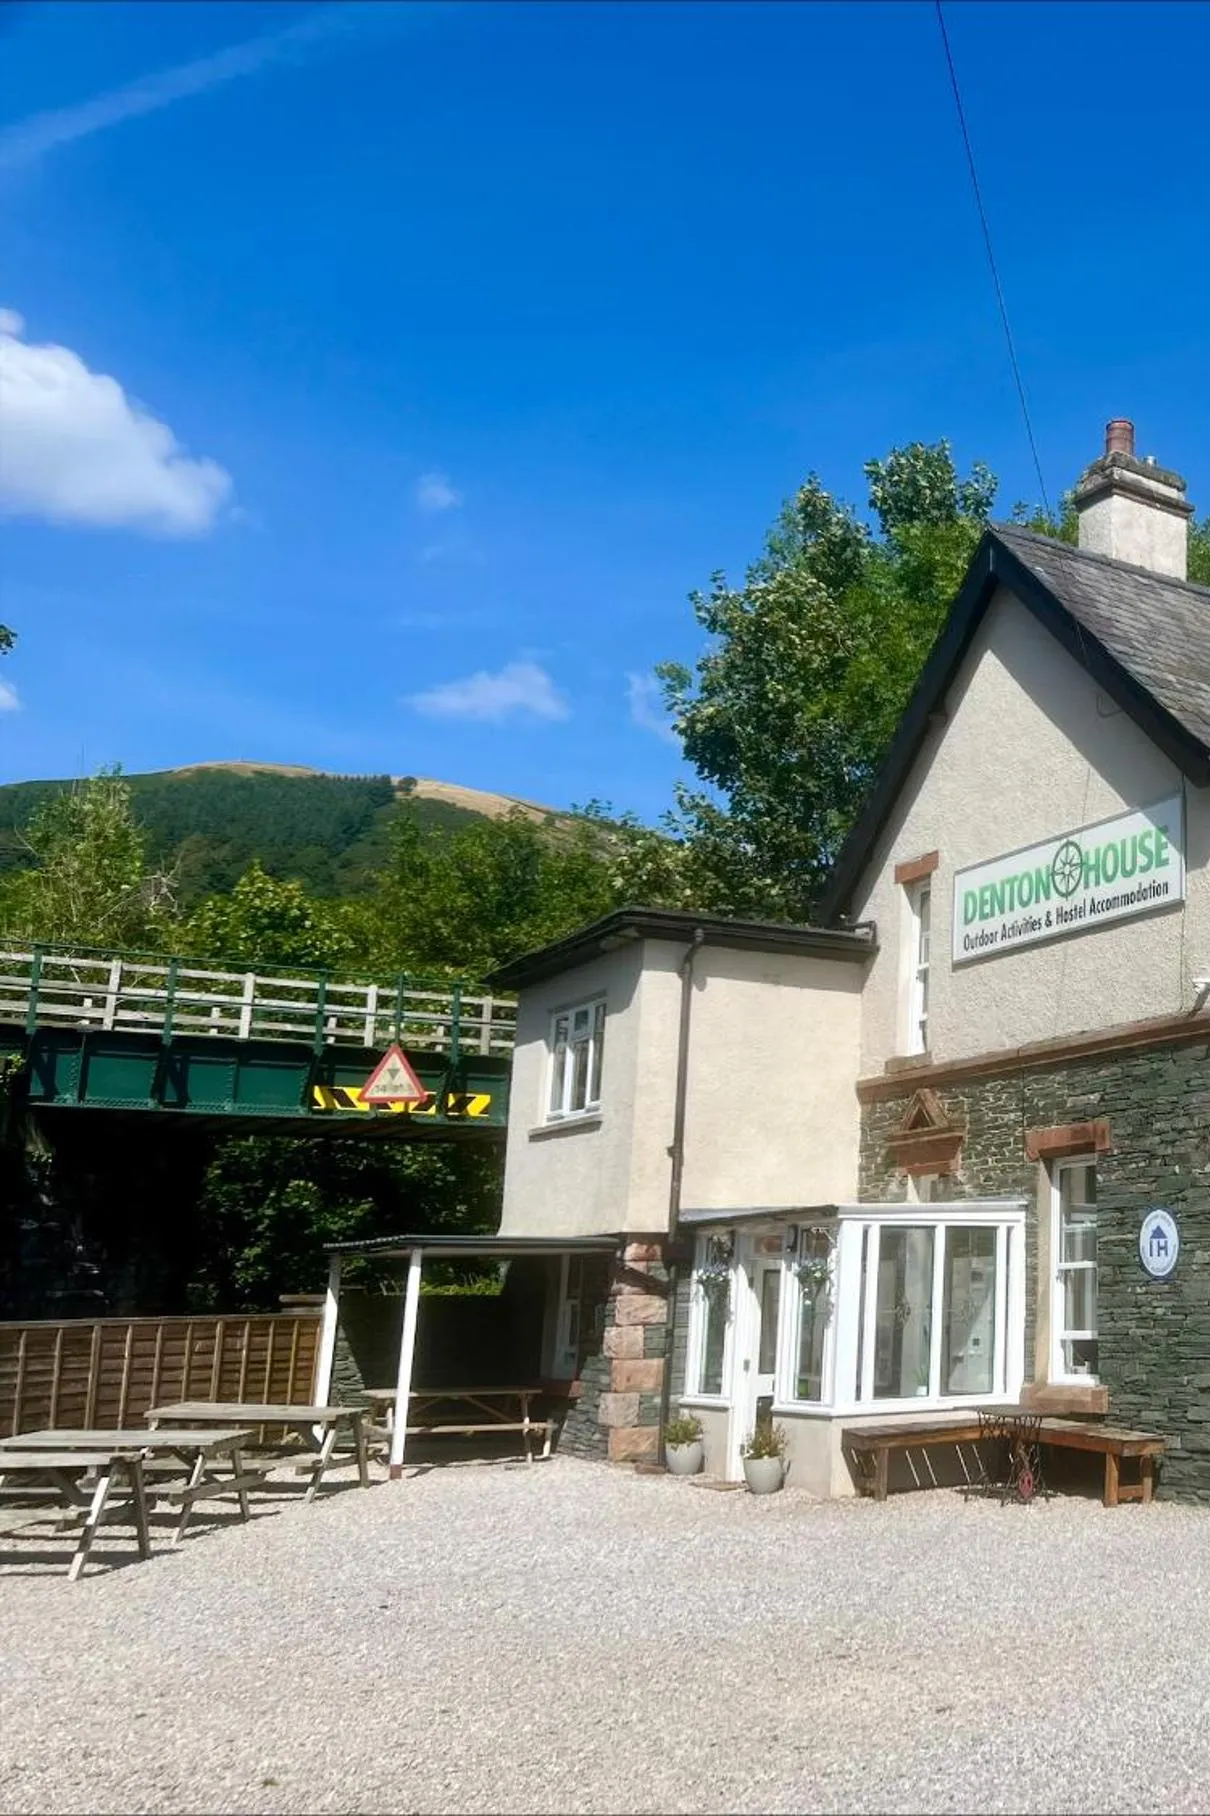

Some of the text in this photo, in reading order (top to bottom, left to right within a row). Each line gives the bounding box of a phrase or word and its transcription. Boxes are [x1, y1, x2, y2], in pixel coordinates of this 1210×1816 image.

[963, 825, 1169, 926] DENTON HOUSE
[963, 880, 1169, 951] Outdoor Activities & Hostel Accommodation
